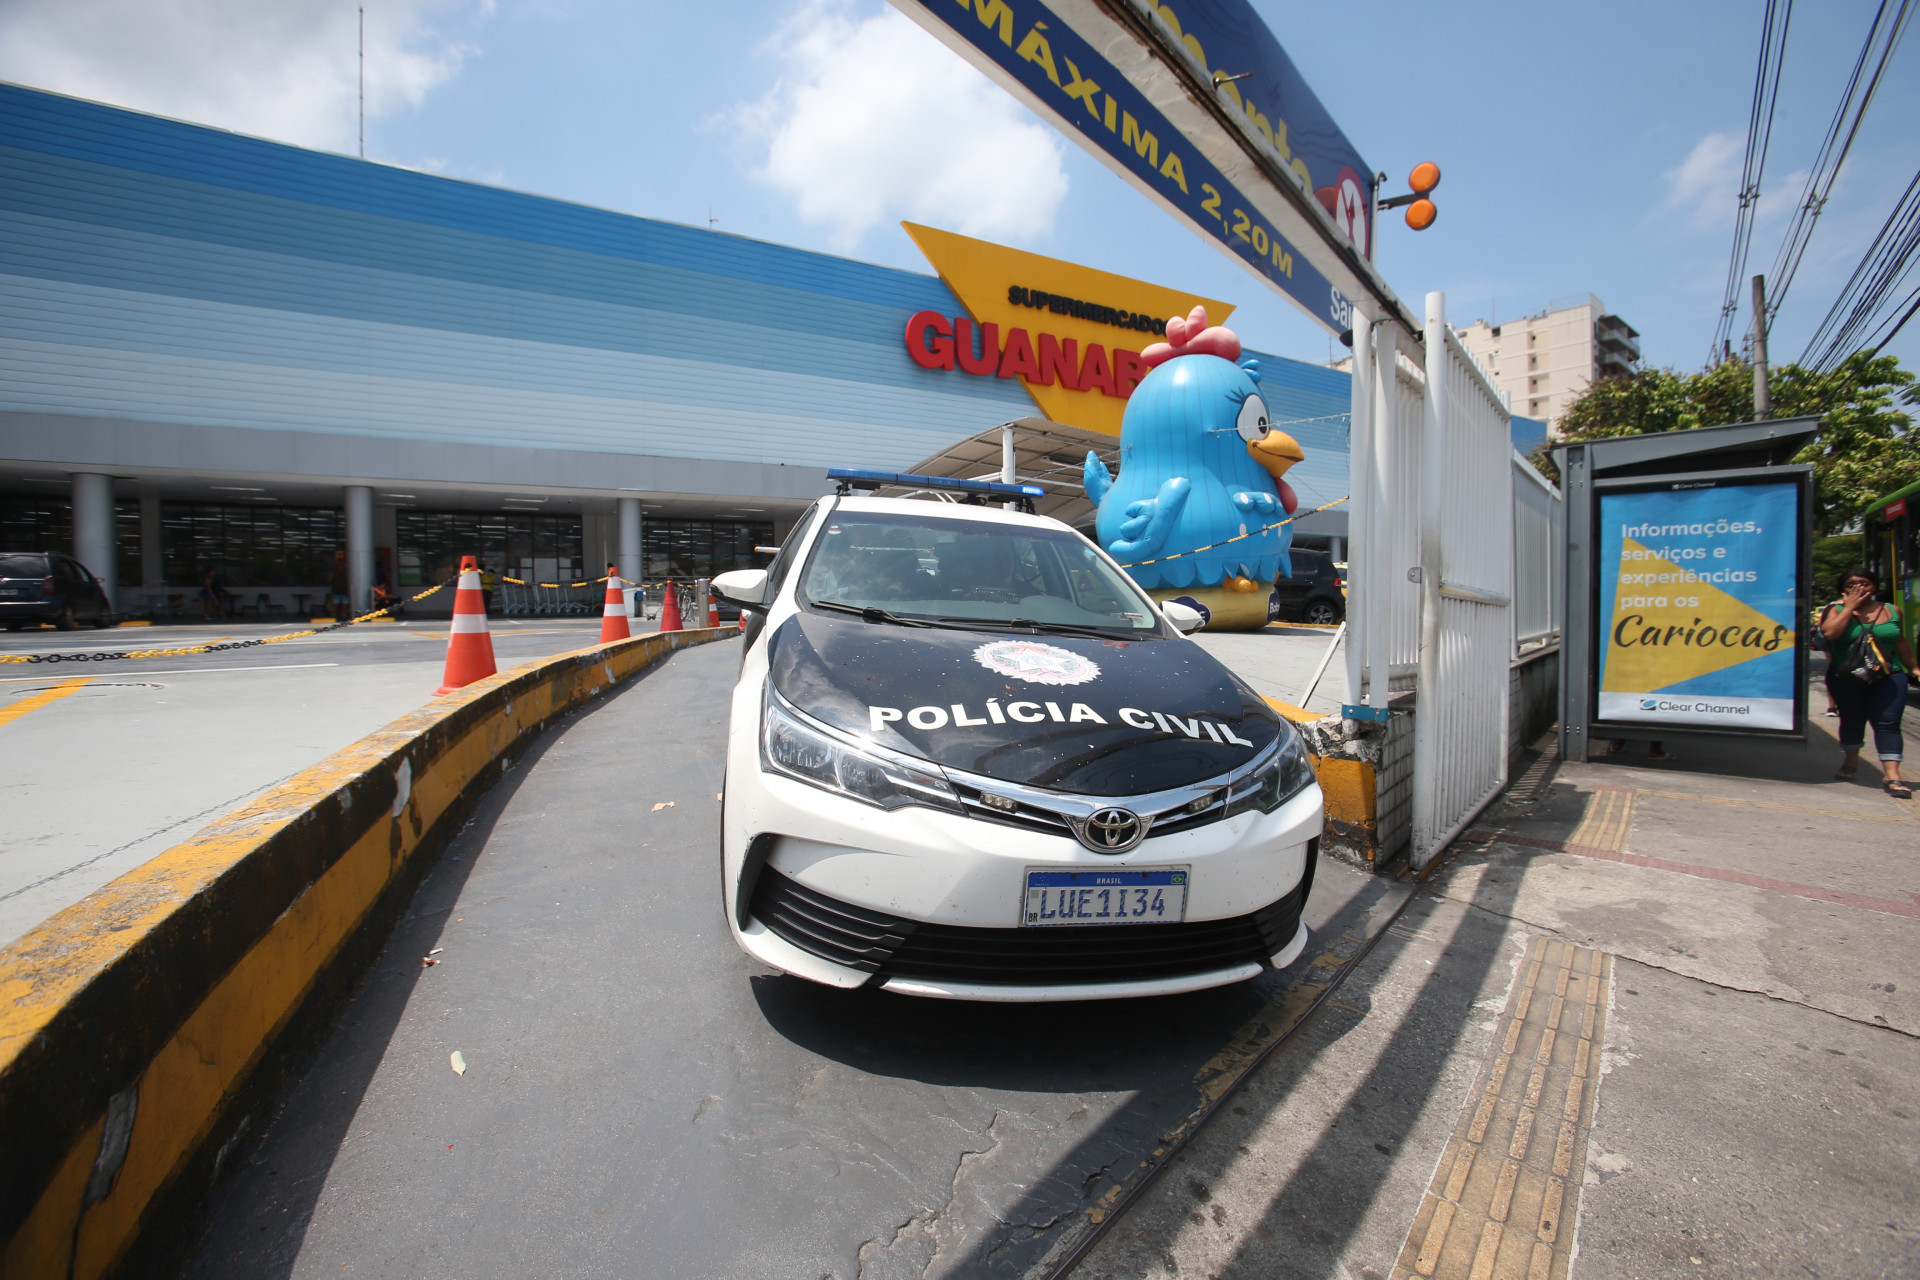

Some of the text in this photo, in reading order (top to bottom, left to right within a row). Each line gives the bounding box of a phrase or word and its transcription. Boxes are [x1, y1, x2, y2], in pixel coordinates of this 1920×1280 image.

[955, 0, 1293, 279] MÁXIMA 2,20 M
[1008, 285, 1168, 337] SUPERMERCADO
[1330, 286, 1354, 329] Sai
[905, 310, 1147, 399] GUANAB
[1621, 519, 1762, 538] Informações,
[1621, 546, 1727, 563] serviços e
[1620, 568, 1758, 587] experiências
[1620, 596, 1699, 610] para os
[1614, 614, 1788, 651] Cariocas
[1659, 701, 1750, 715] Clear Channel
[868, 697, 1254, 748] POLÍCIA CIVIL
[1096, 877, 1122, 885] BRASIL
[1040, 888, 1165, 919] LUE1I34
[1028, 912, 1038, 923] BR
